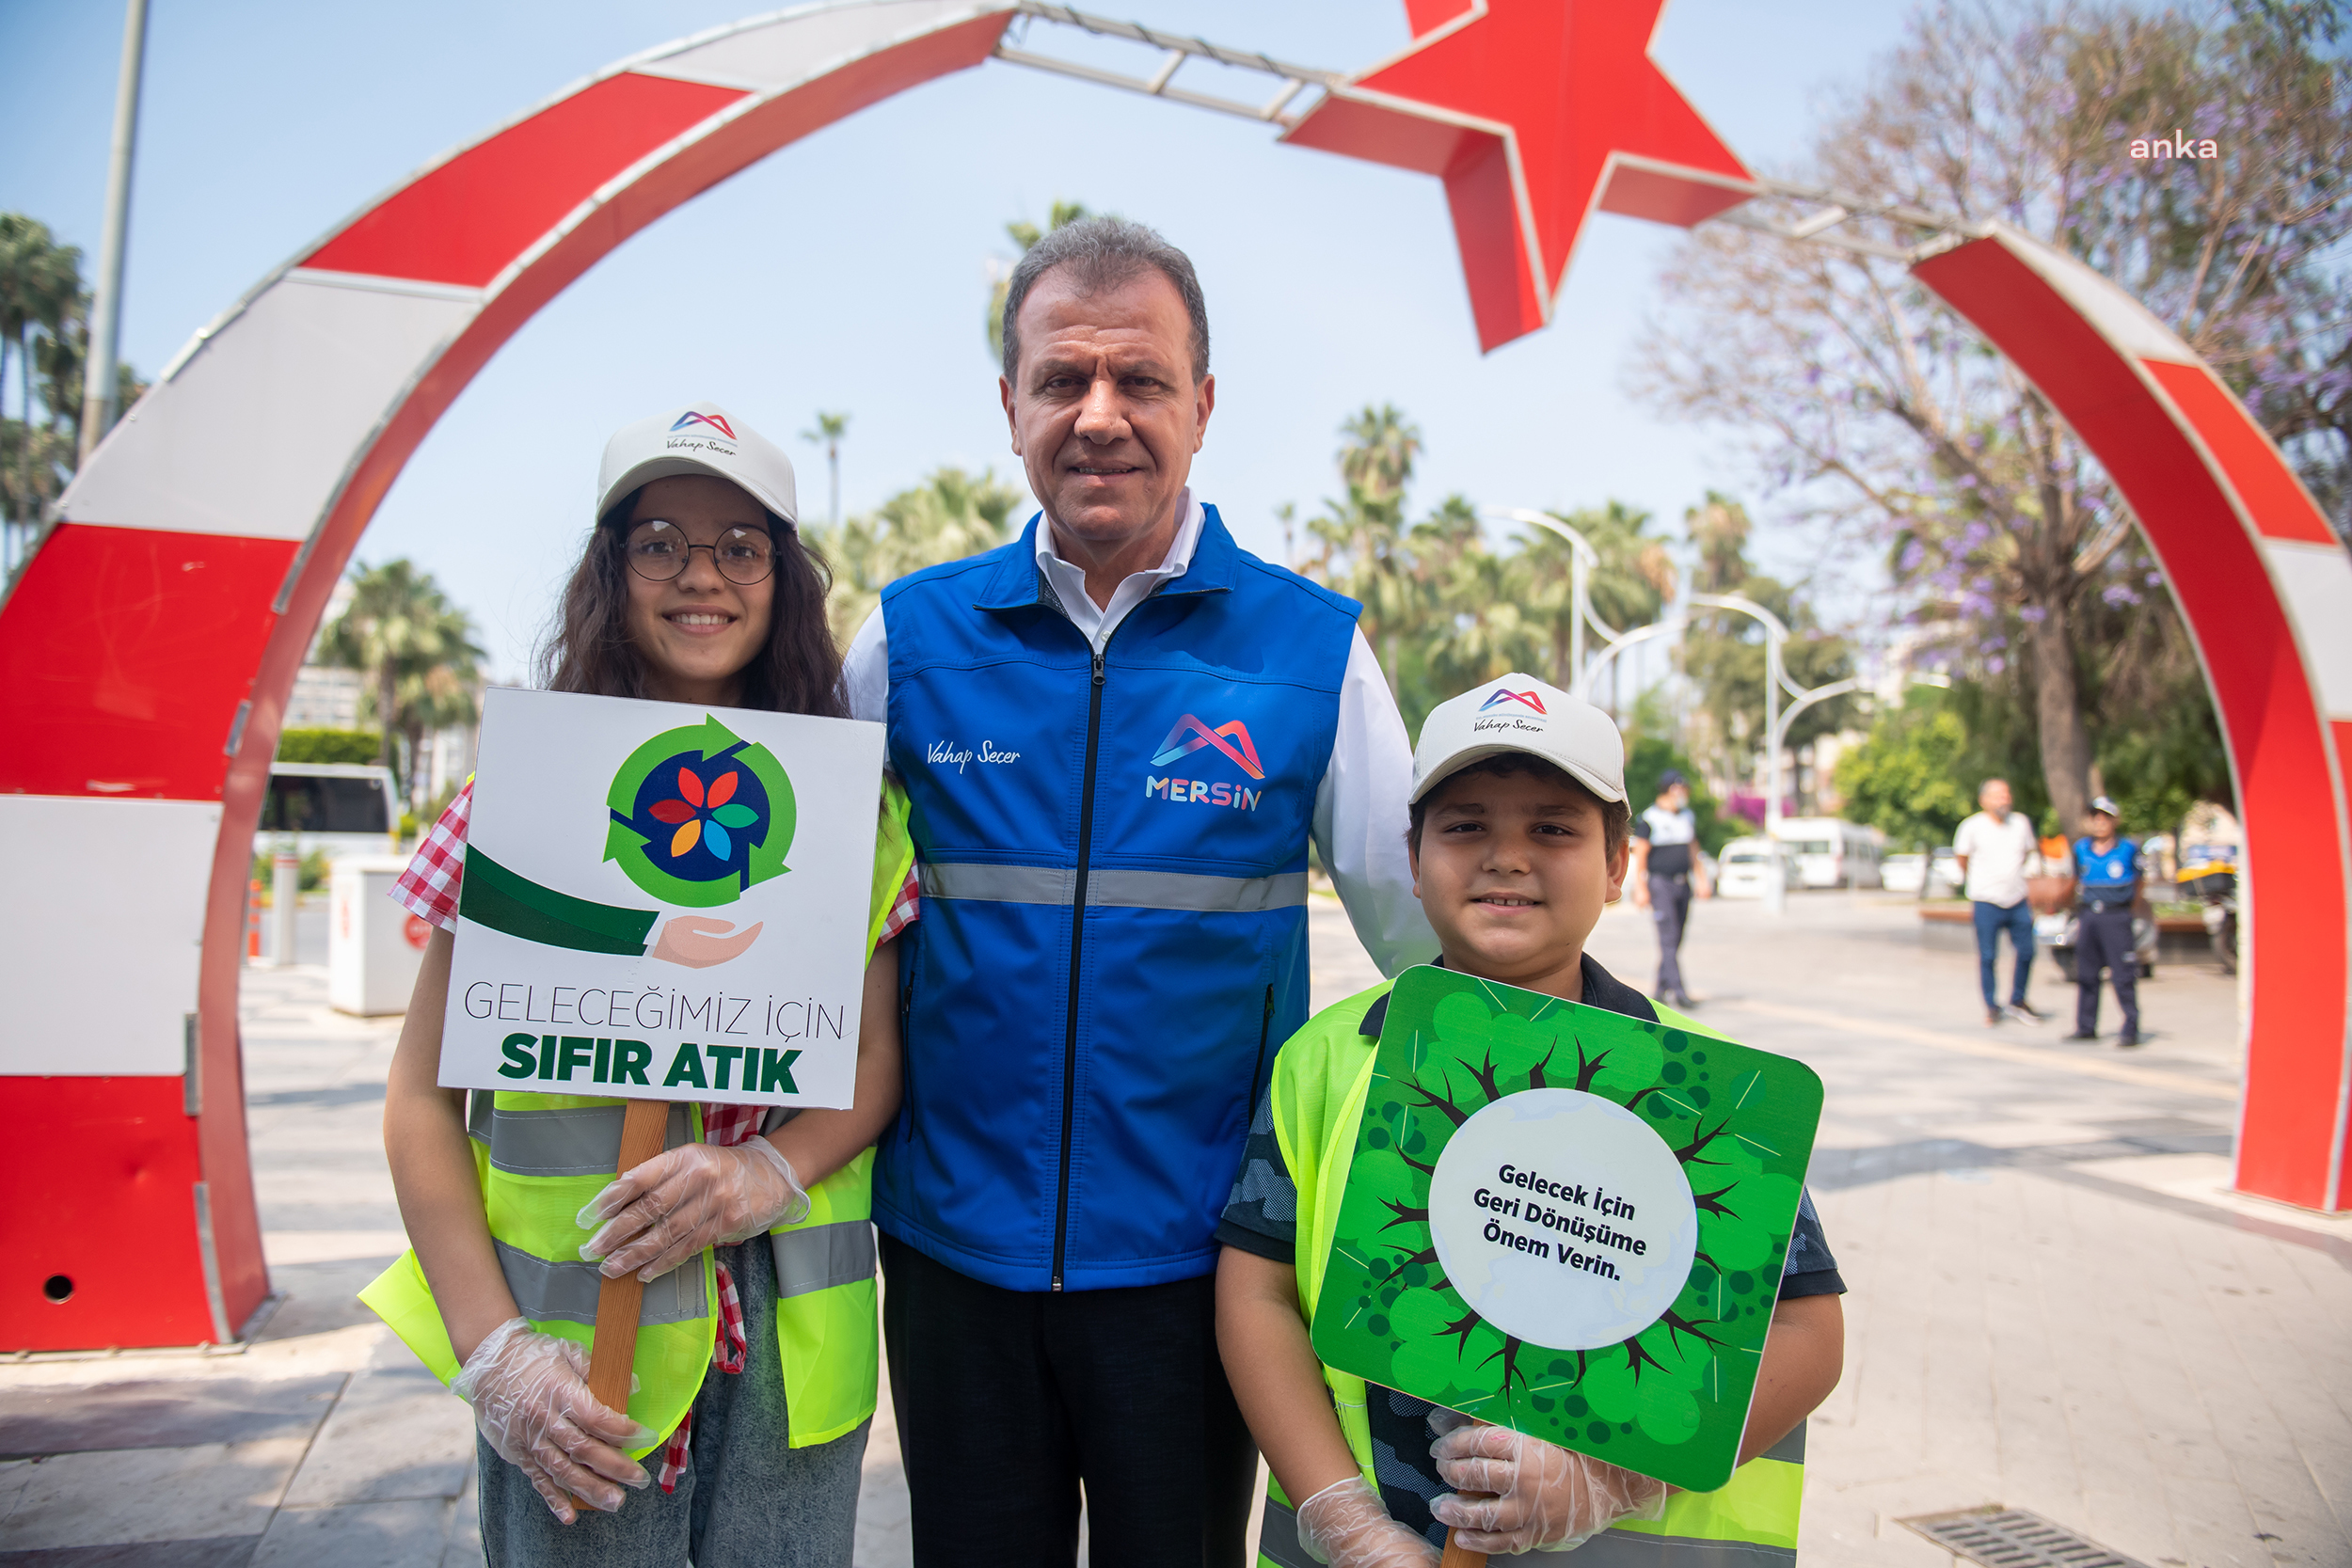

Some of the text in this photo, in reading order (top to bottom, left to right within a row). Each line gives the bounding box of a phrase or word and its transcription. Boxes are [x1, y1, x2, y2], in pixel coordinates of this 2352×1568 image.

[667, 438, 704, 451] Vahap
[1474, 719, 1510, 733] Vahap
[927, 739, 973, 775] Vahap
[464, 980, 845, 1043] GELECEĞİMİZ İÇİN
[497, 1032, 803, 1095] SIFIR ATIK
[1473, 1188, 1647, 1257] Geri Dönüşüme
[1498, 1164, 1636, 1221] Gelecek İçin
[1483, 1217, 1621, 1281] Önem Verin.
